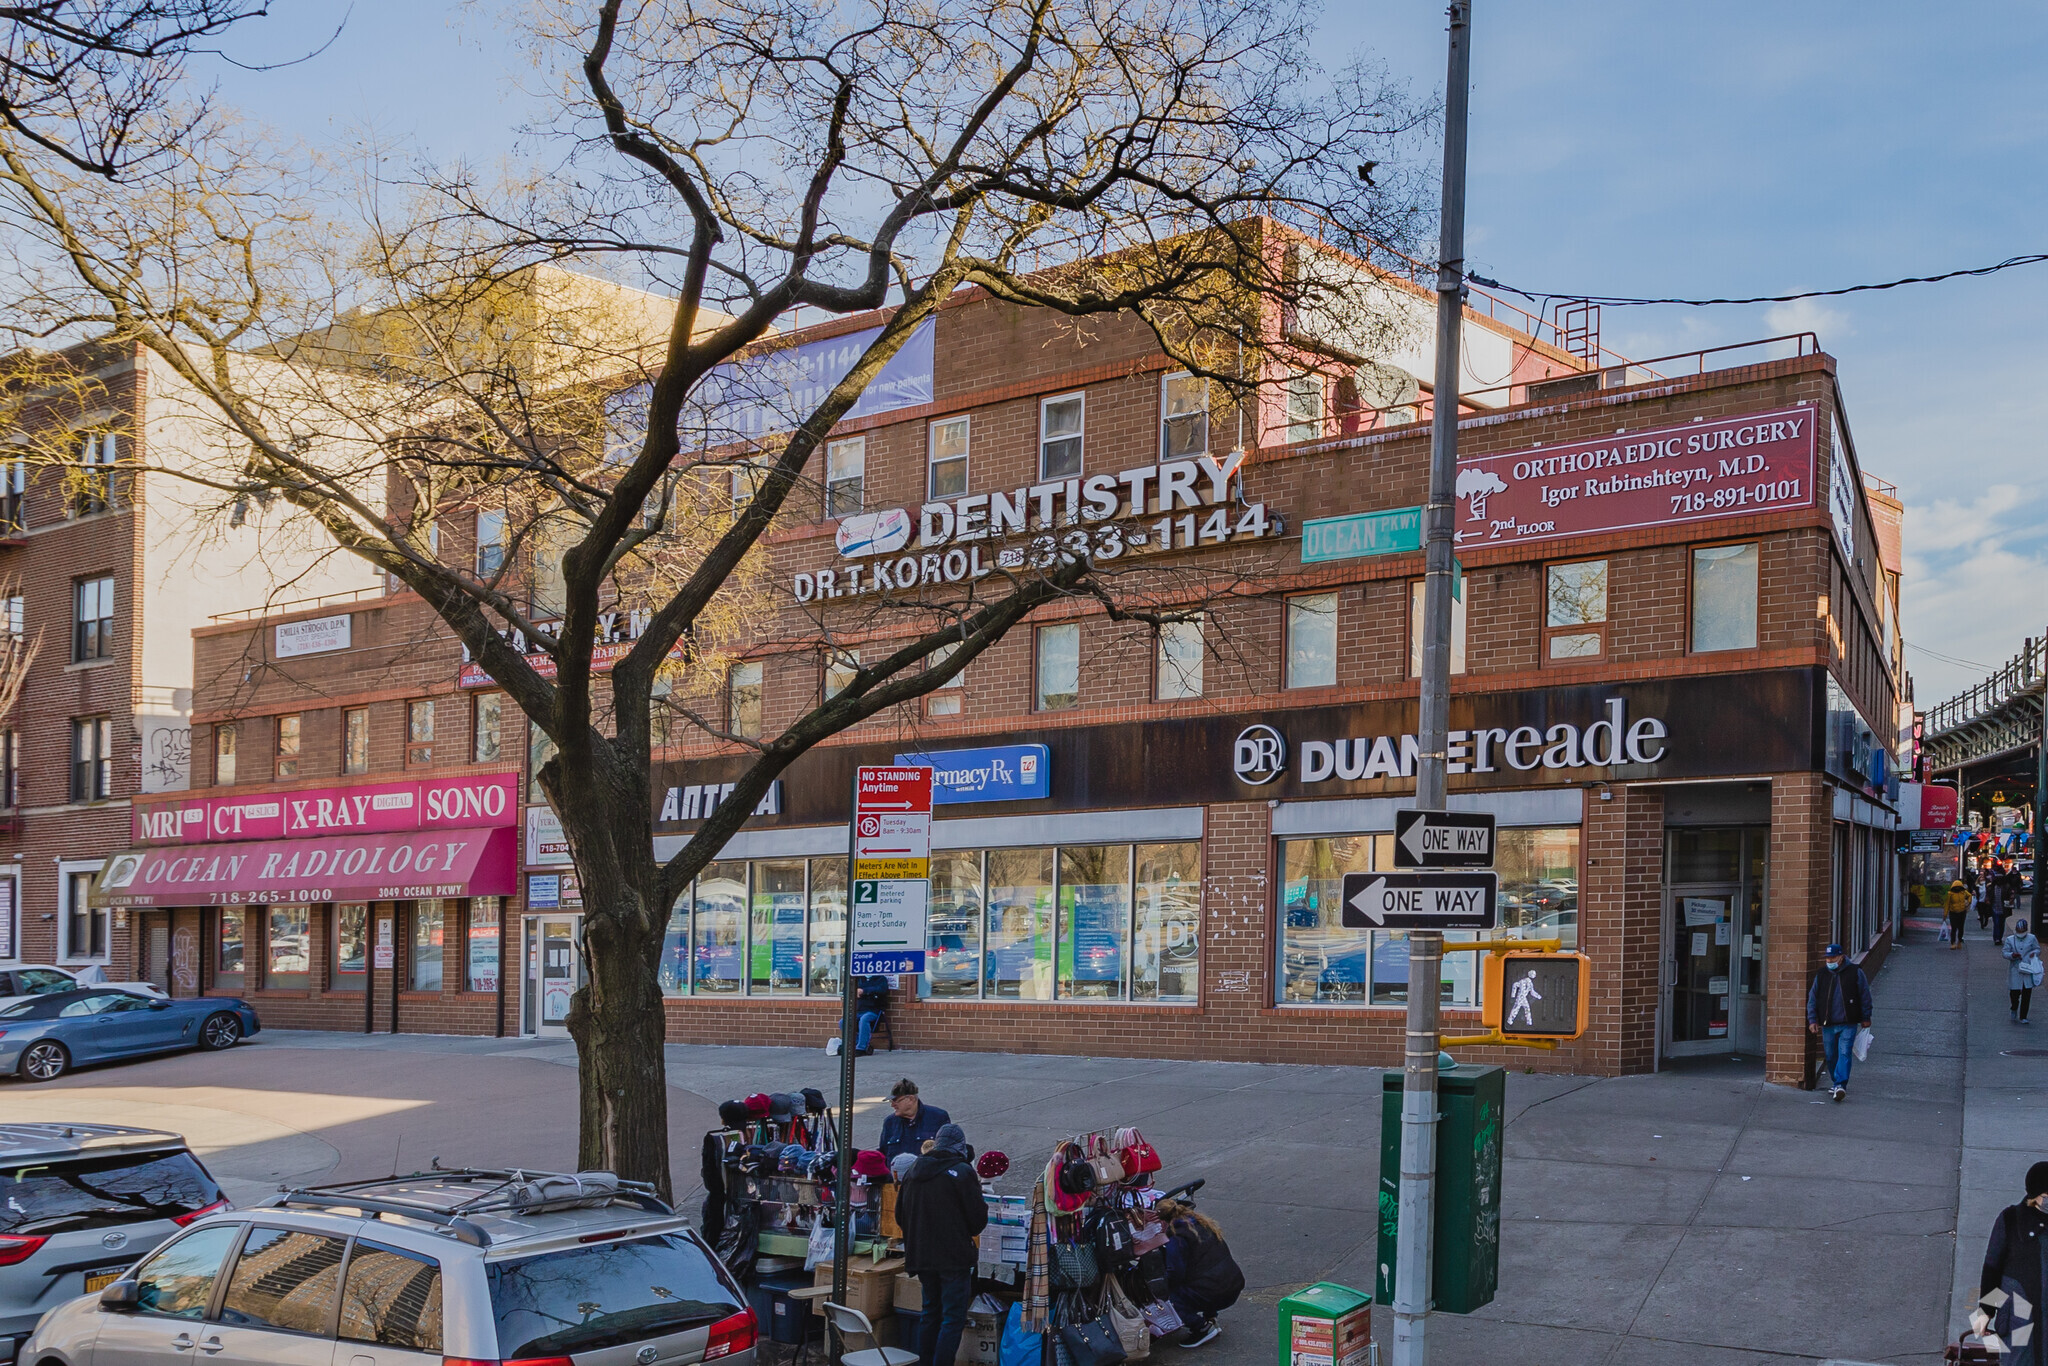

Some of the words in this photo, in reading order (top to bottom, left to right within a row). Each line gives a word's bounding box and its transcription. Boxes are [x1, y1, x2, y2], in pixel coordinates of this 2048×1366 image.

[865, 384, 878, 396] for
[879, 381, 896, 394] new
[896, 373, 931, 392] patients
[1512, 437, 1682, 482] ORTHOPAEDIC
[1686, 417, 1805, 455] SURGERY
[1540, 484, 1579, 510] Igor
[1584, 465, 1713, 499] Rubinshteyn,
[1717, 453, 1771, 480] M.D.
[920, 452, 1249, 546] DENTISTRY
[1669, 478, 1803, 517] 718-891-0101
[1307, 519, 1377, 556] OCEAN
[1381, 513, 1418, 533] PKWY
[1490, 516, 1515, 540] 2nd
[1516, 520, 1556, 537] FLOOR
[873, 544, 990, 594] KOROL
[1233, 737, 1282, 775] DR
[862, 771, 875, 781] NO
[877, 771, 921, 781] STANDING
[862, 783, 899, 794] Anytime
[291, 796, 372, 830] X-RAY
[376, 795, 410, 809] DIGITAL
[426, 783, 506, 821] SONO
[140, 811, 183, 839] MRI
[214, 806, 246, 834] CT
[883, 818, 907, 828] Tuesday
[882, 827, 895, 835] 8am
[900, 827, 921, 835] 9:30am
[1422, 828, 1450, 850] ONE
[1456, 829, 1485, 851] WAY
[145, 854, 248, 885] OCEAN
[258, 842, 468, 880] RADIOLOGY
[858, 862, 882, 871] Meters
[884, 861, 895, 870] Are
[896, 861, 908, 870] Not
[910, 861, 918, 869] In
[858, 871, 881, 880] Effect
[882, 871, 902, 880] Above
[903, 870, 922, 879] Times
[209, 888, 333, 905] 718-265-1000
[378, 886, 400, 898] 3049
[403, 884, 433, 897] OCEAN
[436, 883, 463, 896] PKWY
[860, 882, 873, 903] 2
[880, 890, 905, 898] metered
[881, 883, 894, 891] hour
[110, 896, 132, 906] OCEAN
[134, 895, 154, 905] PKWY
[880, 896, 902, 905] parking
[1382, 890, 1423, 912] ONE
[1435, 890, 1480, 912] WAY
[857, 910, 872, 919] 9am
[879, 910, 893, 921] 7pm
[857, 919, 880, 929] Except
[881, 918, 907, 929] Sunday
[1167, 920, 1200, 948] DR
[854, 952, 873, 960] Zone#
[853, 960, 897, 974] 316821
[980, 1340, 996, 1353] LG
